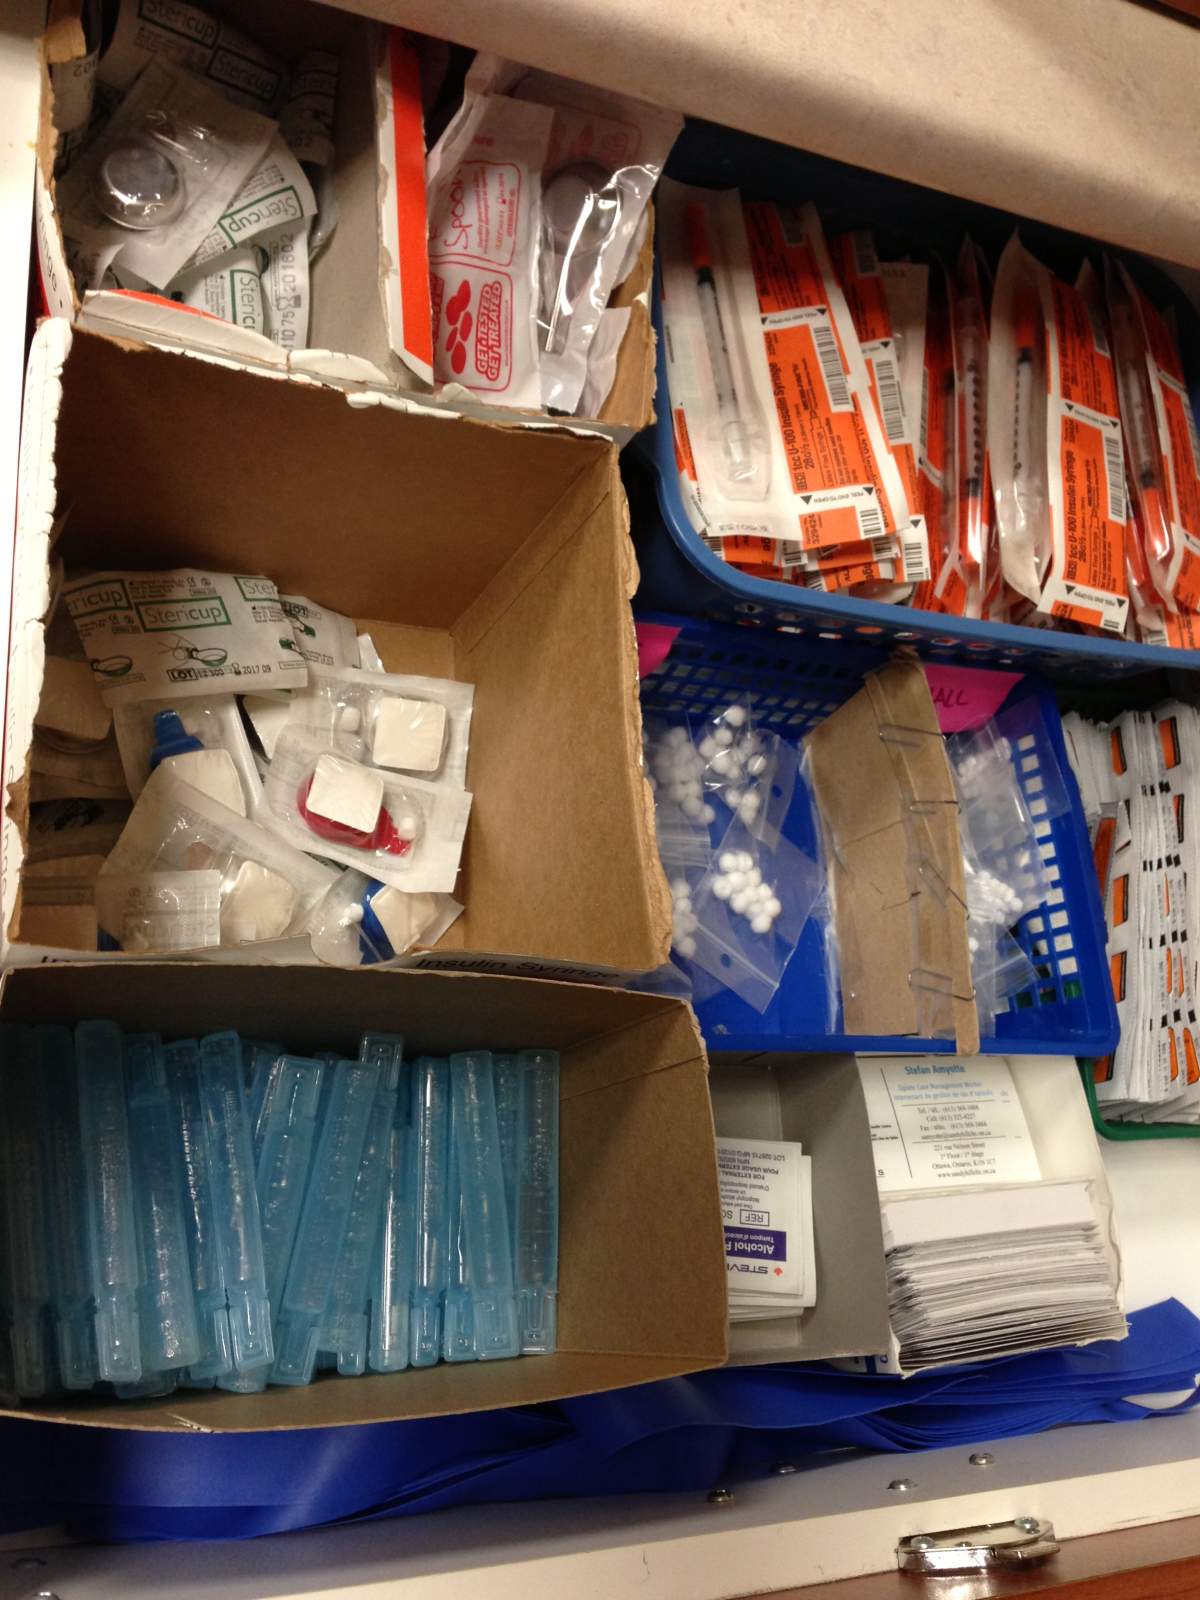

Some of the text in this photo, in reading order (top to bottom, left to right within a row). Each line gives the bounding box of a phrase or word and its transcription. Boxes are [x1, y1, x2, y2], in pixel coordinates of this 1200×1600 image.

[228, 197, 297, 232] Stericup
[240, 277, 258, 330] Steric
[477, 286, 491, 372] GET TESTED
[487, 283, 501, 380] GET TREATED
[768, 362, 785, 396] Syringe
[784, 428, 799, 456] U-100
[1065, 450, 1077, 483] Syringe
[143, 602, 222, 626] Stericup
[169, 668, 195, 681] LOT
[416, 957, 506, 970] Insulin
[744, 1212, 764, 1223] REF
[735, 1240, 775, 1255] Alcohol
